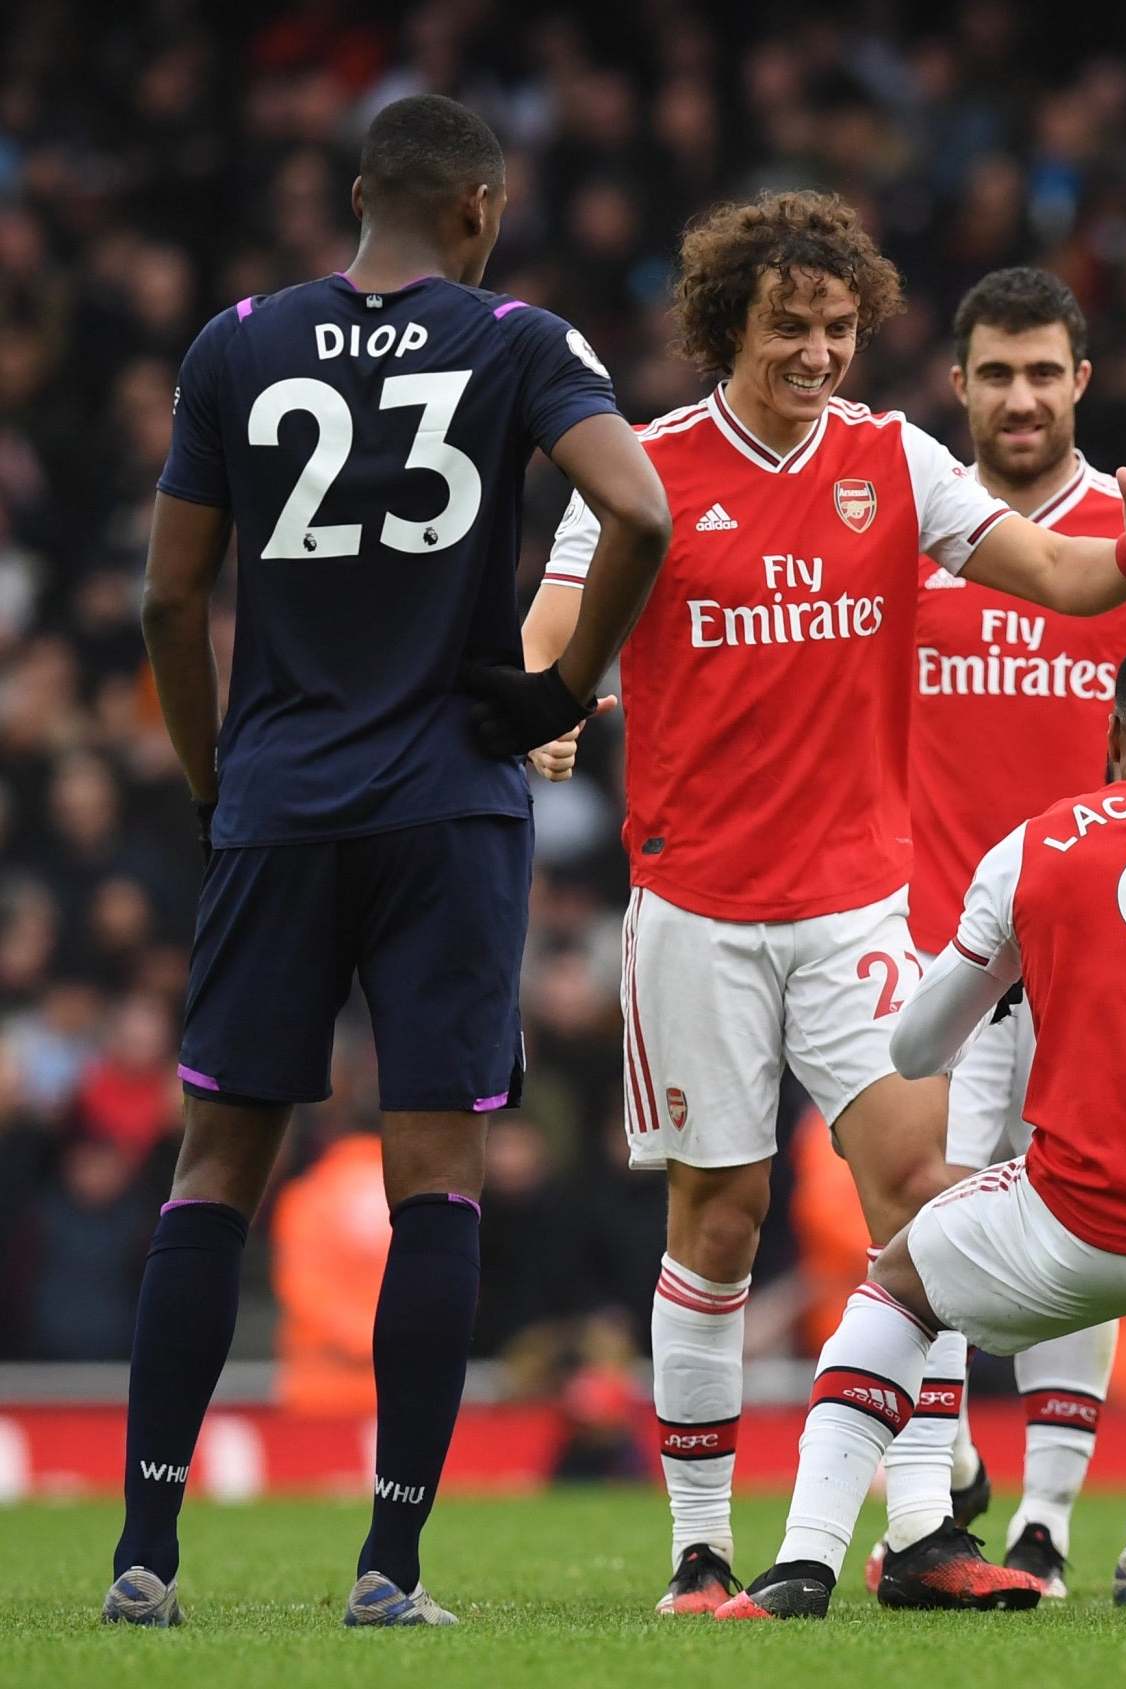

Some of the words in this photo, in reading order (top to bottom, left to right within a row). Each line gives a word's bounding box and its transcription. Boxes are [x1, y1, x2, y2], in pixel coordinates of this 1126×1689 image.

[315, 322, 429, 359] DIOP
[248, 369, 482, 560] 23
[695, 520, 739, 532] adidas
[762, 553, 823, 593] Fly
[687, 592, 885, 648] Emirates
[982, 609, 1046, 651] Fly
[917, 645, 1117, 702] Emirates
[843, 1389, 900, 1423] adidas
[139, 1460, 189, 1483] WHU
[374, 1473, 425, 1503] WHU
